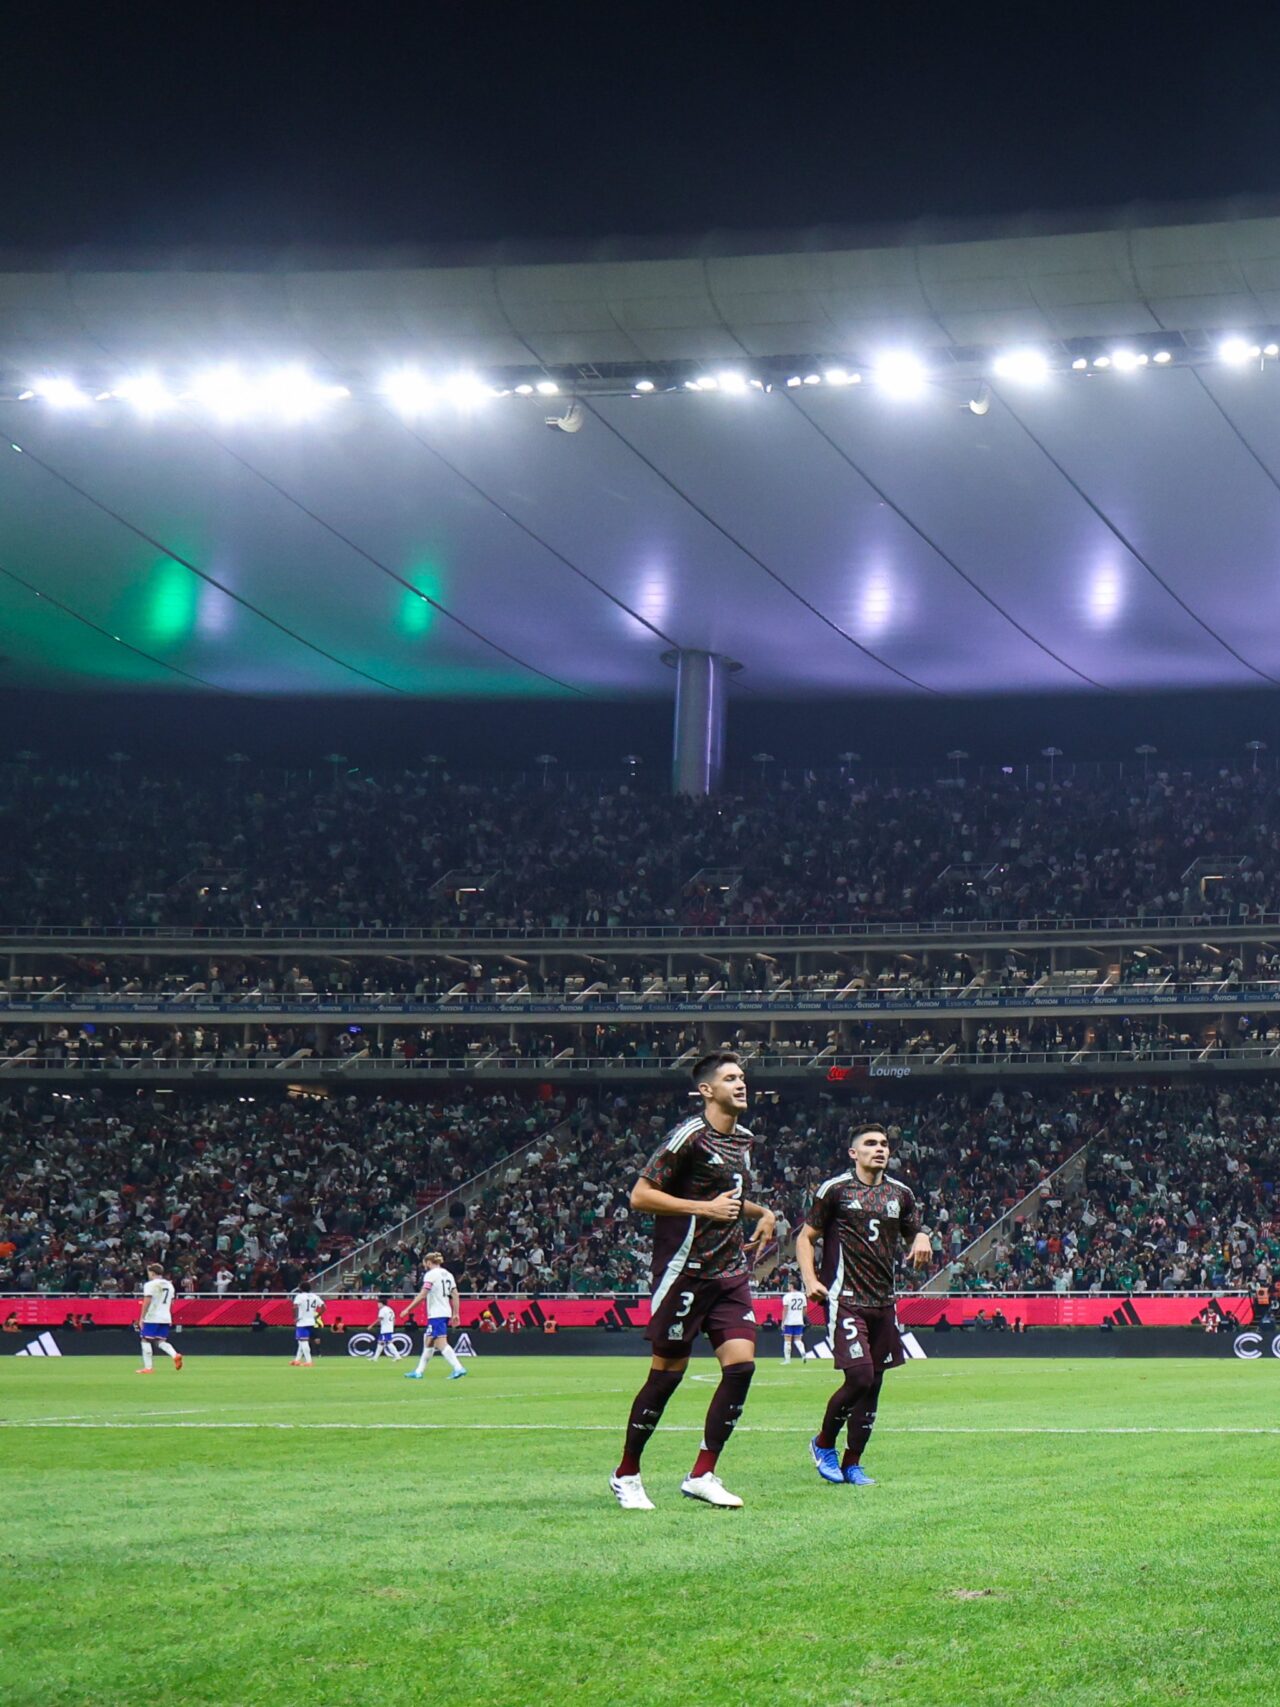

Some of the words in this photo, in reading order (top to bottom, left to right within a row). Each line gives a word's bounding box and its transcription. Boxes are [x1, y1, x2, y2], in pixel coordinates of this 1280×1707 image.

[869, 1067, 911, 1078] Lounge
[731, 1173, 744, 1199] 3
[868, 1218, 881, 1242] 5
[162, 1288, 170, 1304] 7
[440, 1279, 452, 1298] 13
[305, 1299, 317, 1312] 14
[675, 1291, 695, 1317] 3
[790, 1298, 804, 1311] 22
[842, 1317, 858, 1340] 5
[348, 1332, 478, 1357] COA
